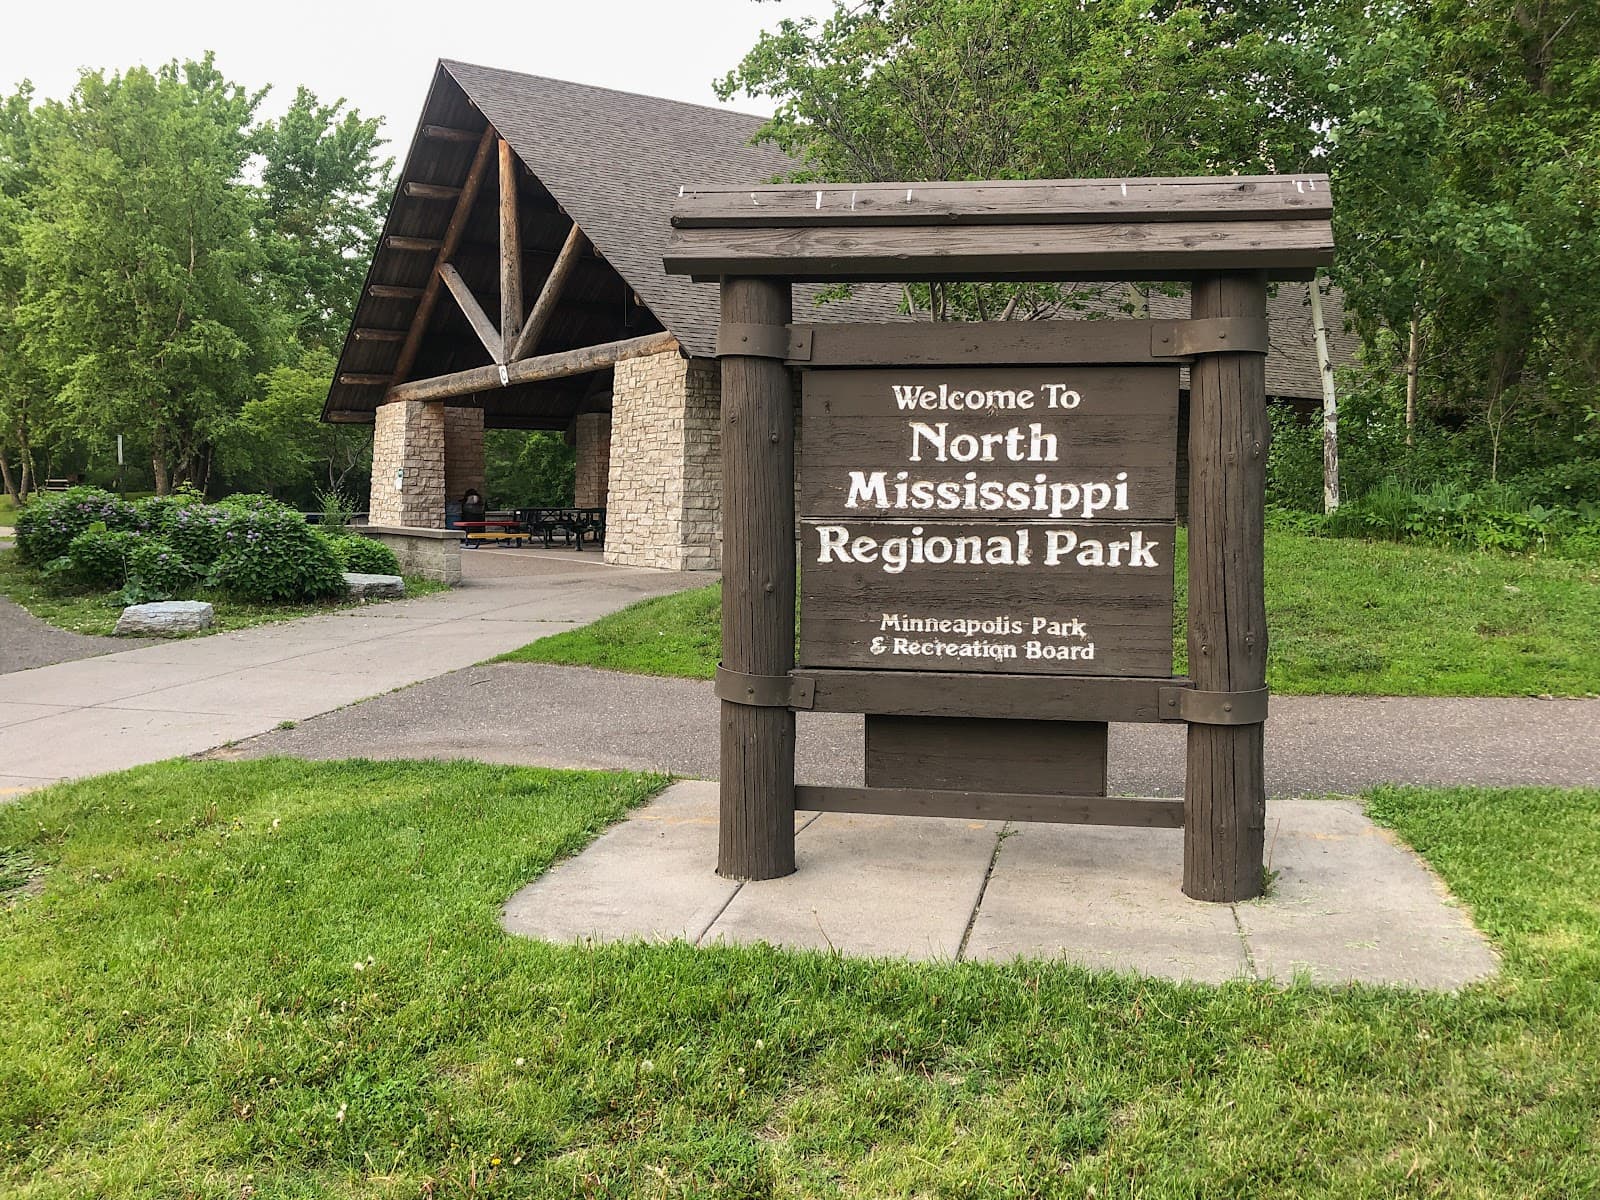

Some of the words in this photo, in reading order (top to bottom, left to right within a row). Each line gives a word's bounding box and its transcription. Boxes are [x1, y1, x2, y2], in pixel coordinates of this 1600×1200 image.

[891, 383, 1035, 411] Welcome
[1040, 383, 1081, 410] To
[908, 421, 1059, 462] North
[843, 471, 1130, 519] Mississippi
[814, 524, 1032, 574] Regional
[1043, 529, 1160, 568] Park
[879, 613, 1023, 637] Minneapolis
[1031, 616, 1087, 638] Park
[869, 636, 887, 655] &
[892, 637, 1018, 659] Recreation
[1025, 639, 1095, 660] Board
